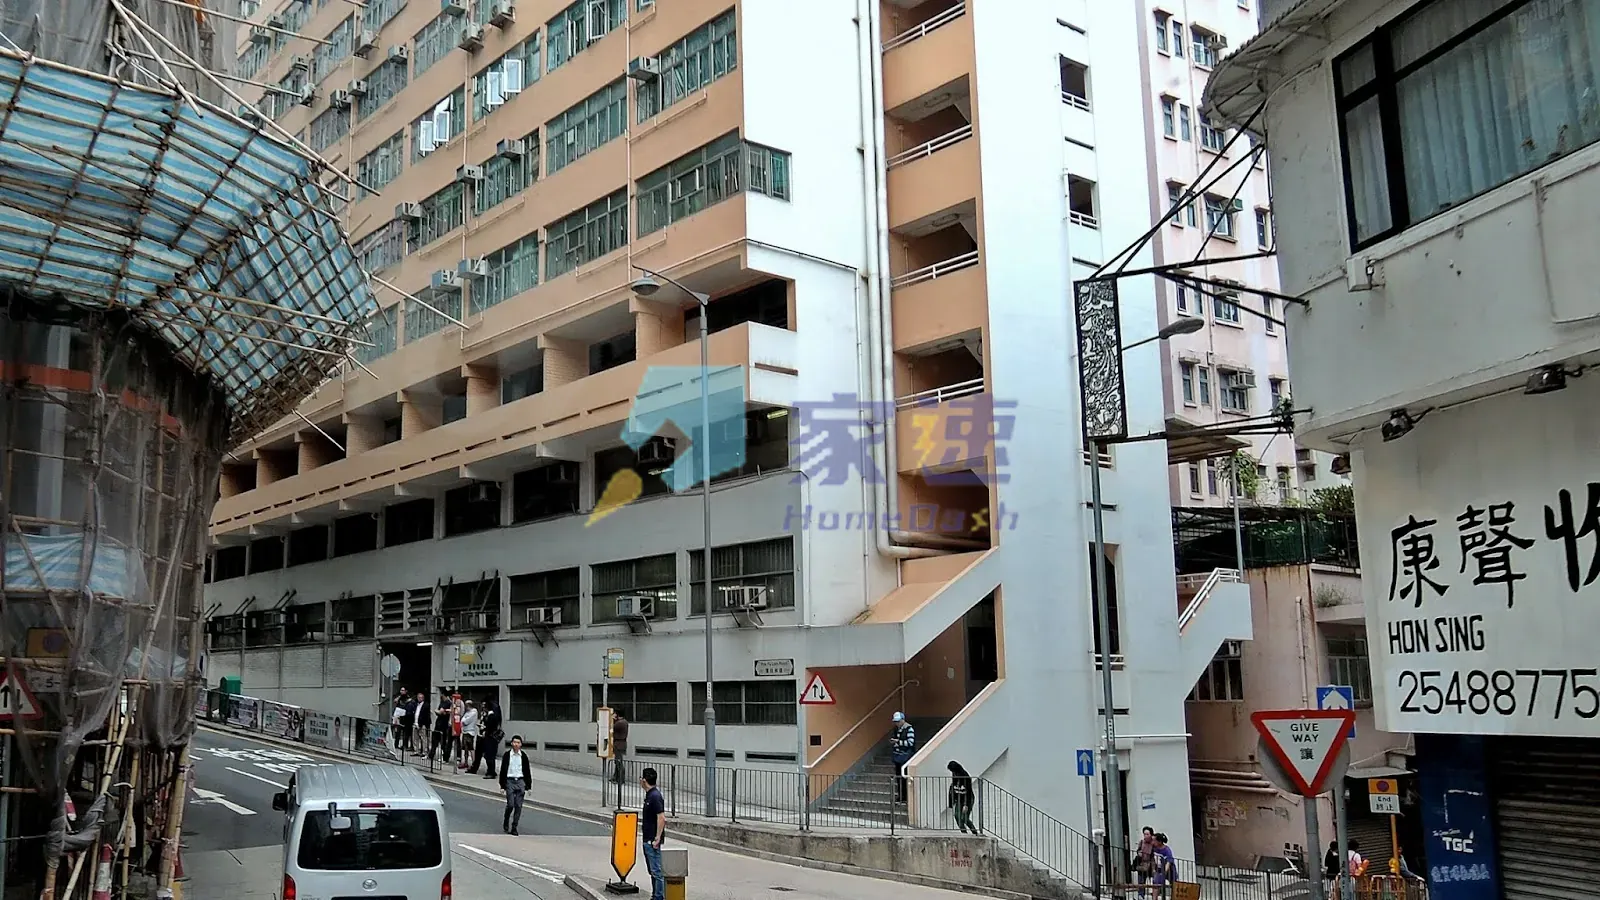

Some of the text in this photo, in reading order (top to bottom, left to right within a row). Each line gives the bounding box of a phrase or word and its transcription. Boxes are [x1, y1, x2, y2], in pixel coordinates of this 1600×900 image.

[1388, 615, 1485, 654] HON SING
[1398, 669, 1600, 720] 25488775
[1290, 723, 1319, 732] GIVE
[1292, 734, 1319, 743] WAY
[1442, 836, 1474, 853] TGC
